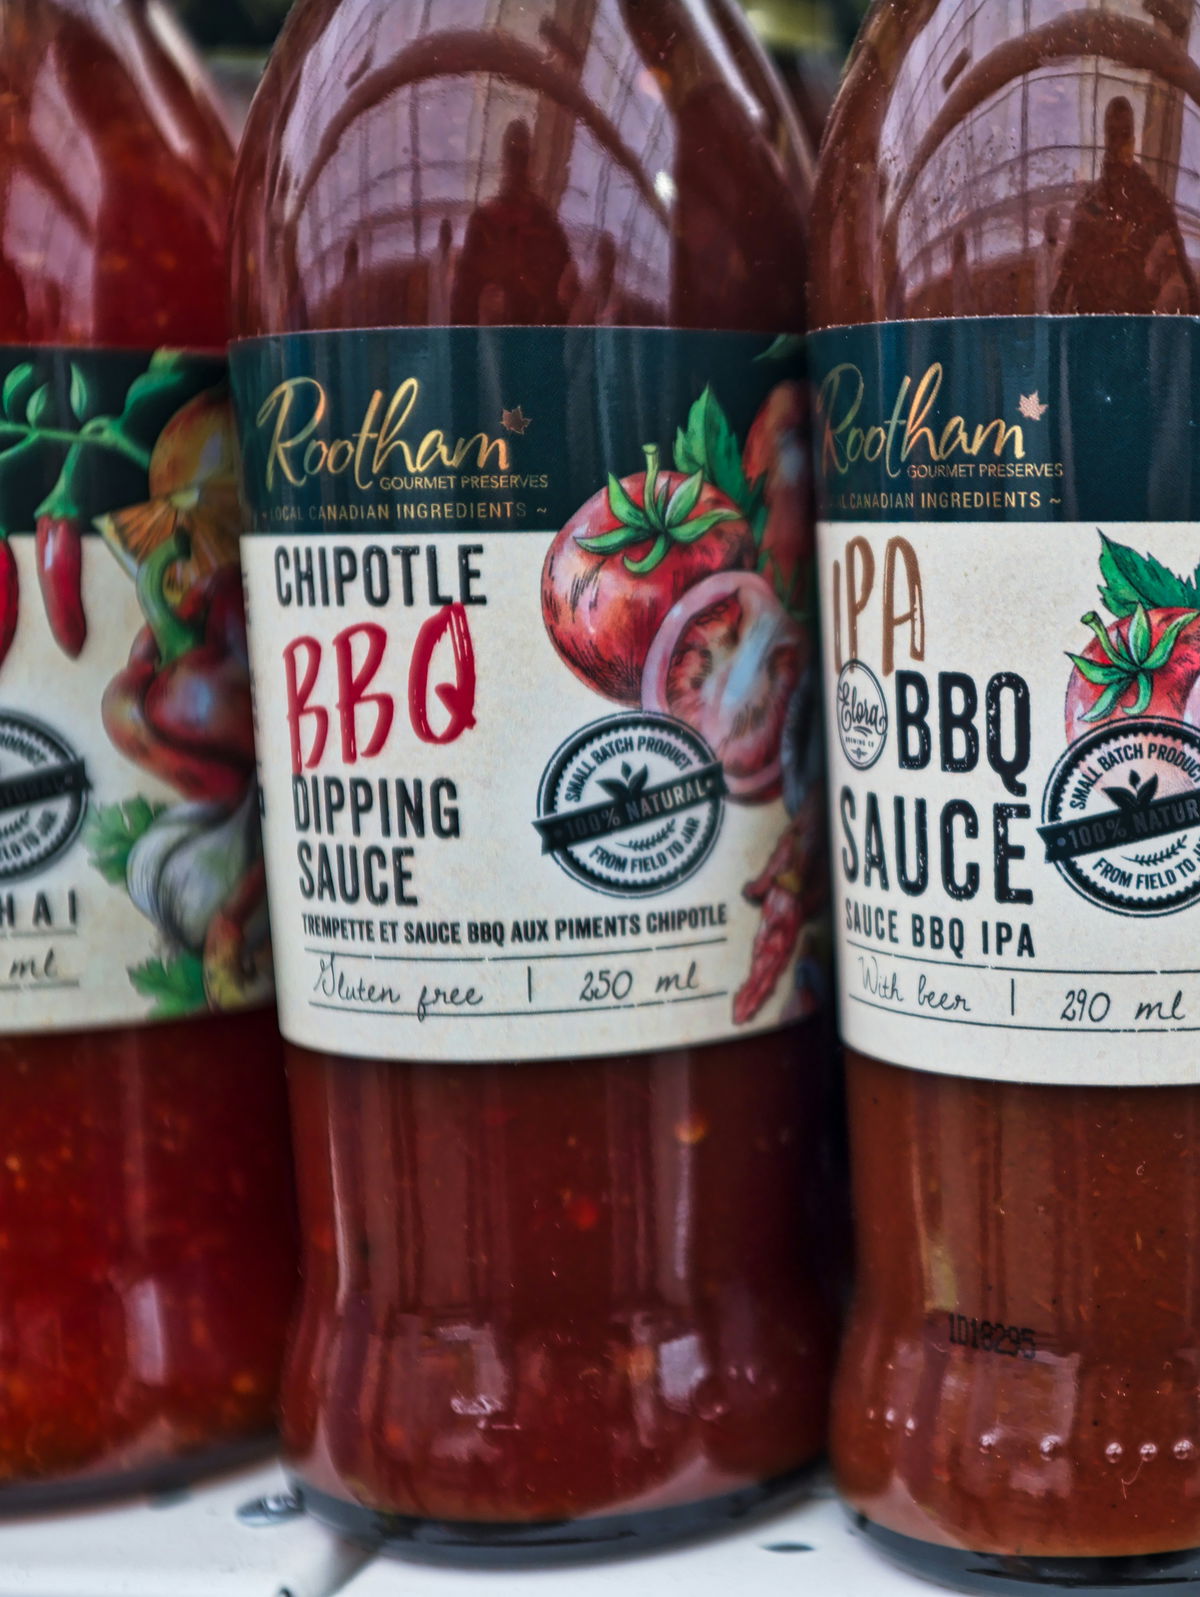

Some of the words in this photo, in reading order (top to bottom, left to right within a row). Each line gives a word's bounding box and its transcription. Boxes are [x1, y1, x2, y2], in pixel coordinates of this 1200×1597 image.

[257, 376, 510, 493] Rootham
[815, 361, 1026, 479] Rootham
[379, 476, 455, 490] GOURMET
[461, 474, 549, 489] PRESERVES
[849, 493, 914, 509] CANADIAN
[921, 491, 1042, 509] INGREDIENTS
[907, 464, 977, 479] GOURMET
[979, 463, 1064, 478] PRESERVES
[308, 503, 390, 521] CANADIAN
[396, 501, 528, 519] INGREDIENTS
[274, 543, 487, 607] CHIPOTLE
[833, 535, 926, 677] IPA
[282, 602, 477, 773] BBQ
[839, 681, 889, 736] Elora
[895, 669, 1031, 797] BBQ
[565, 761, 597, 802] SMALL
[590, 736, 634, 765] BATCH
[637, 735, 693, 771] PRODUCT
[1069, 766, 1104, 810] SMALL
[1097, 743, 1144, 772] BATCH
[292, 774, 460, 839] DIPPING
[625, 778, 706, 821] NATURAL
[588, 845, 627, 874] FROM
[630, 854, 669, 874] FIELD
[666, 841, 685, 860] TO
[680, 816, 700, 844] JAR
[840, 784, 1035, 905] SAUCE
[1068, 817, 1128, 850] 100%
[297, 843, 419, 907] SAUCE
[1091, 857, 1133, 889] FROM
[1135, 868, 1178, 890] FIELD
[1174, 857, 1197, 878] TO
[302, 913, 375, 944] TREMPETTE
[379, 920, 400, 944] ET
[404, 920, 461, 944] SAUCE
[467, 920, 505, 948] BBQ
[511, 917, 549, 943] AUX
[555, 912, 640, 942] PIMENTS
[646, 902, 728, 933] CHIPOTLE
[845, 900, 900, 945] SAUCE
[911, 917, 967, 958] BBQ
[981, 921, 1036, 959] IPA
[313, 951, 401, 1005] Gluten
[416, 984, 484, 1022] free
[578, 967, 634, 1001] 250
[654, 960, 699, 993] ml
[857, 954, 904, 1004] With
[917, 971, 972, 1013] beer
[1059, 989, 1111, 1024] 290
[1134, 988, 1187, 1022] ml
